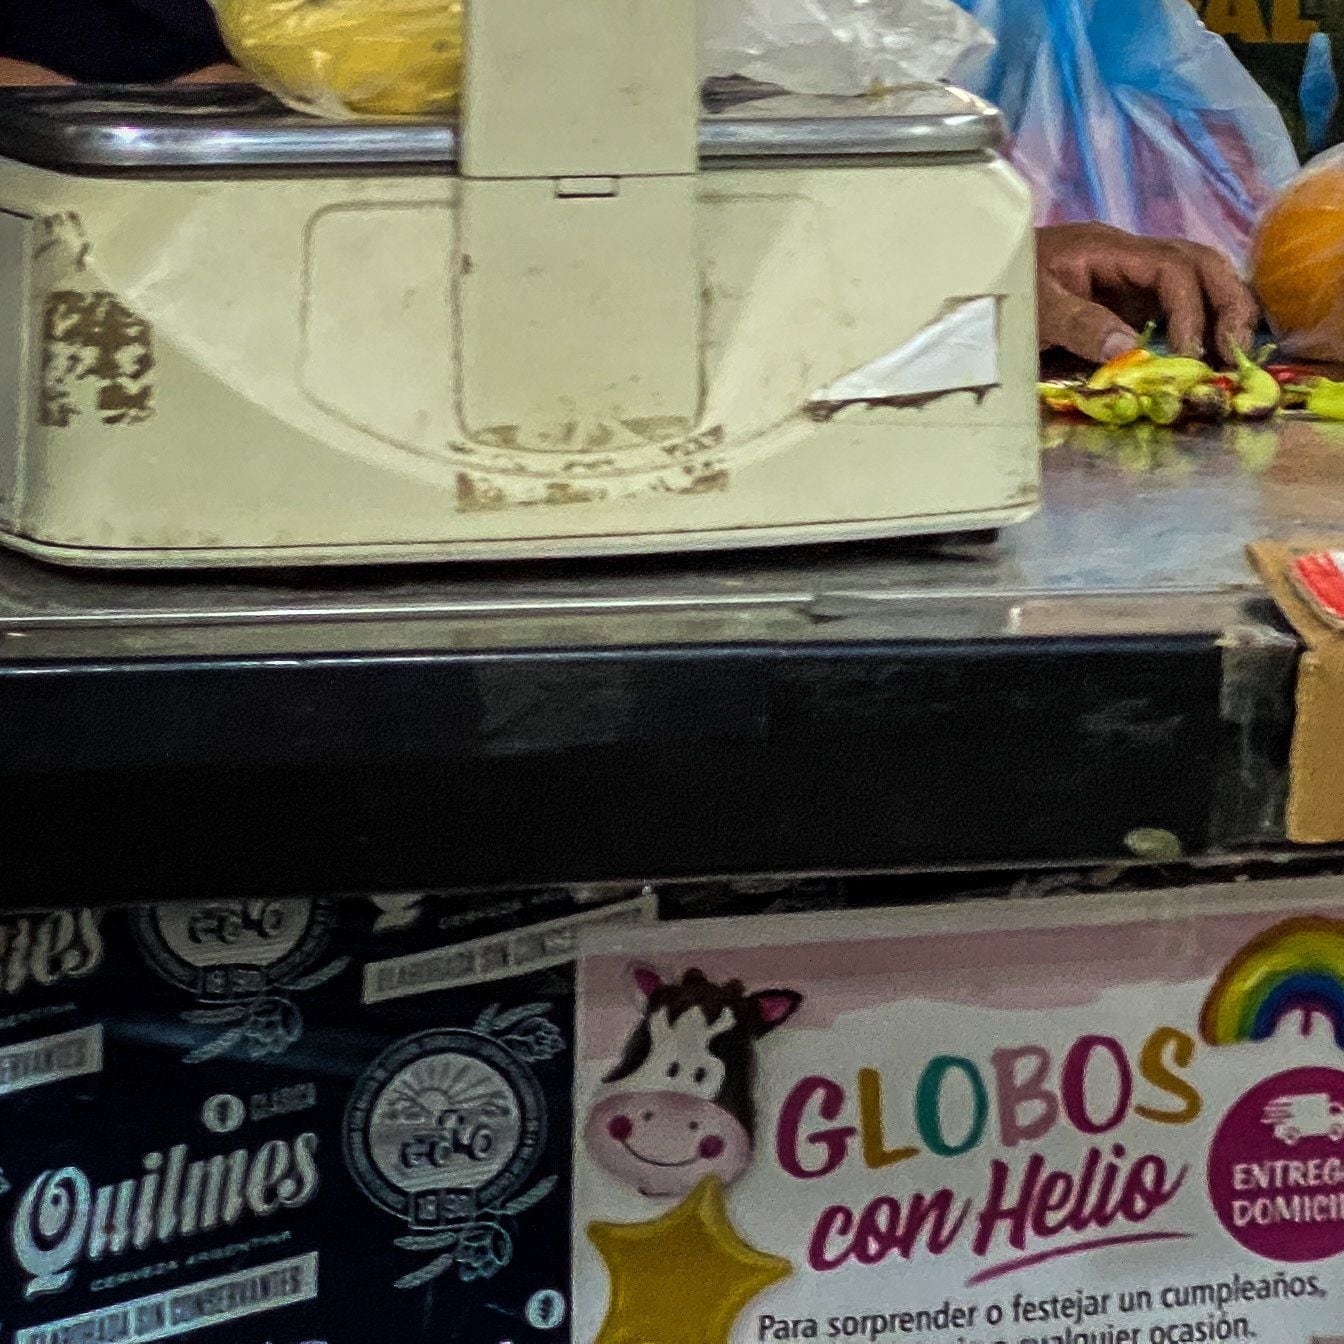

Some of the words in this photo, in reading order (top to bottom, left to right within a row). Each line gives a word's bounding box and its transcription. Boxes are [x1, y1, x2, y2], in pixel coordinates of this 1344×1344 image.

[776, 1026, 1204, 1180] GLOBOS
[11, 1131, 321, 1300] Quilmes
[807, 1188, 973, 1272] con
[972, 1142, 1190, 1256] Helio
[758, 1314, 819, 1341] Para
[827, 1301, 978, 1342] sorprender
[985, 1303, 1004, 1326] o
[1011, 1289, 1111, 1325] festejar
[1118, 1290, 1152, 1312] un
[1159, 1272, 1327, 1310] cumpleaños,
[1148, 1312, 1258, 1344] ocasión.
